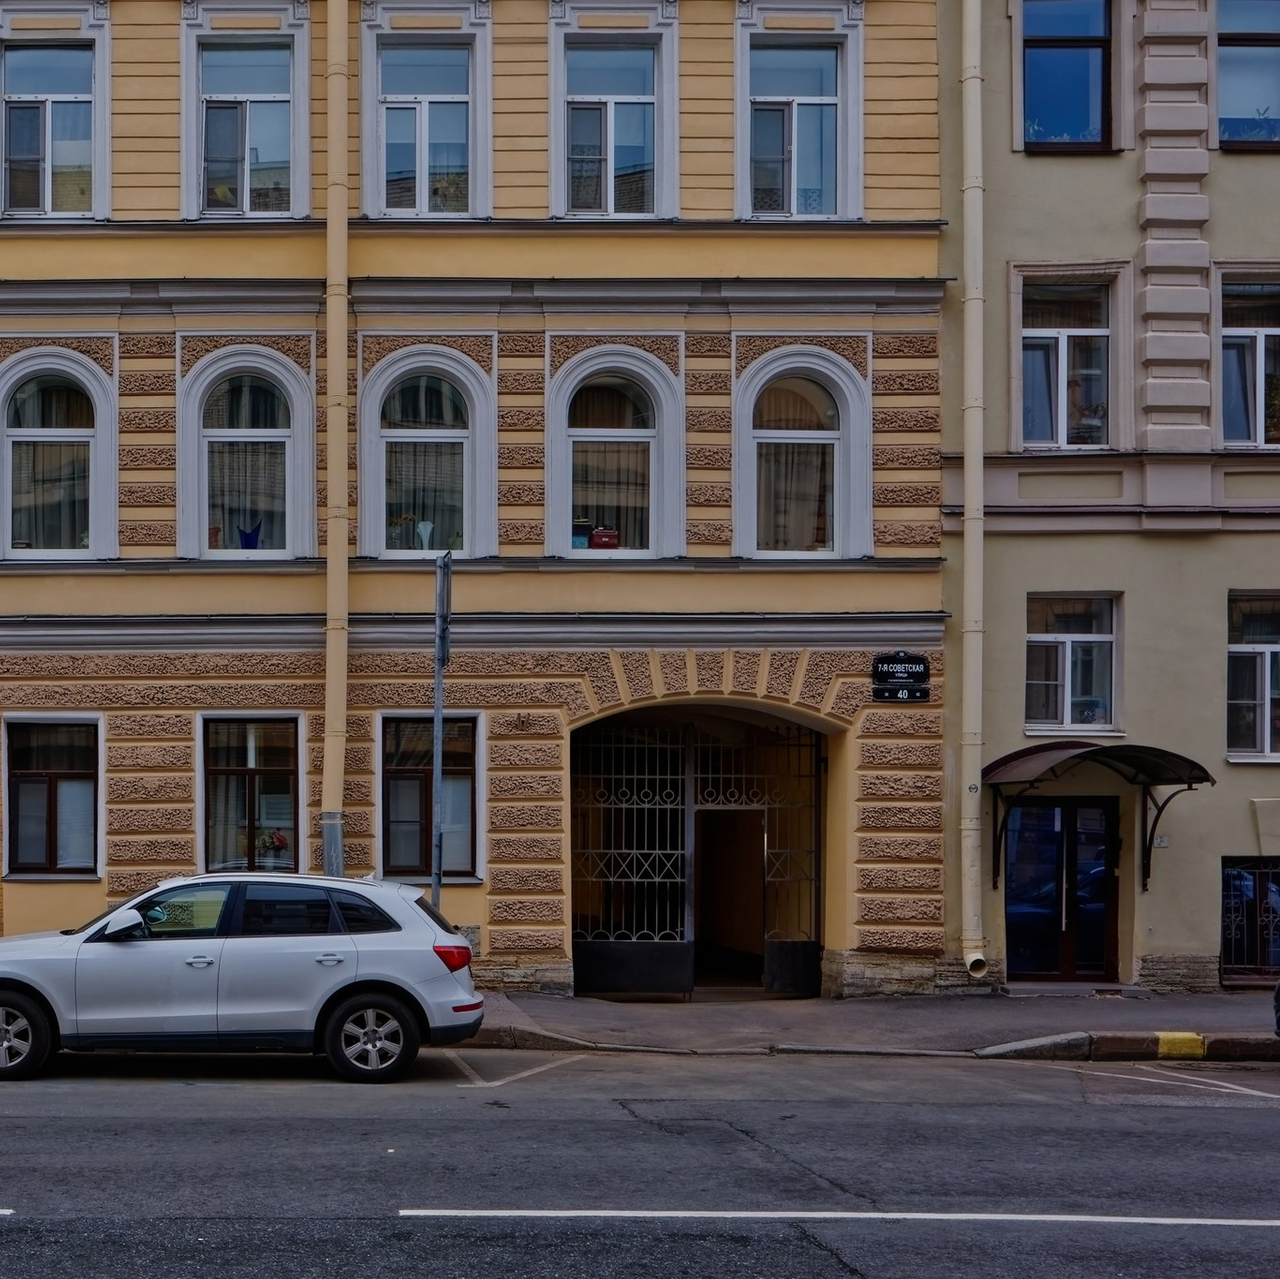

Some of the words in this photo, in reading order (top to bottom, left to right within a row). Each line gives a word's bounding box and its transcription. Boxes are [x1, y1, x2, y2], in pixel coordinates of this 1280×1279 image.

[878, 664, 888, 672] 7-Я
[889, 664, 924, 672] СОВЕТСКАЯ
[897, 689, 908, 699] 40
